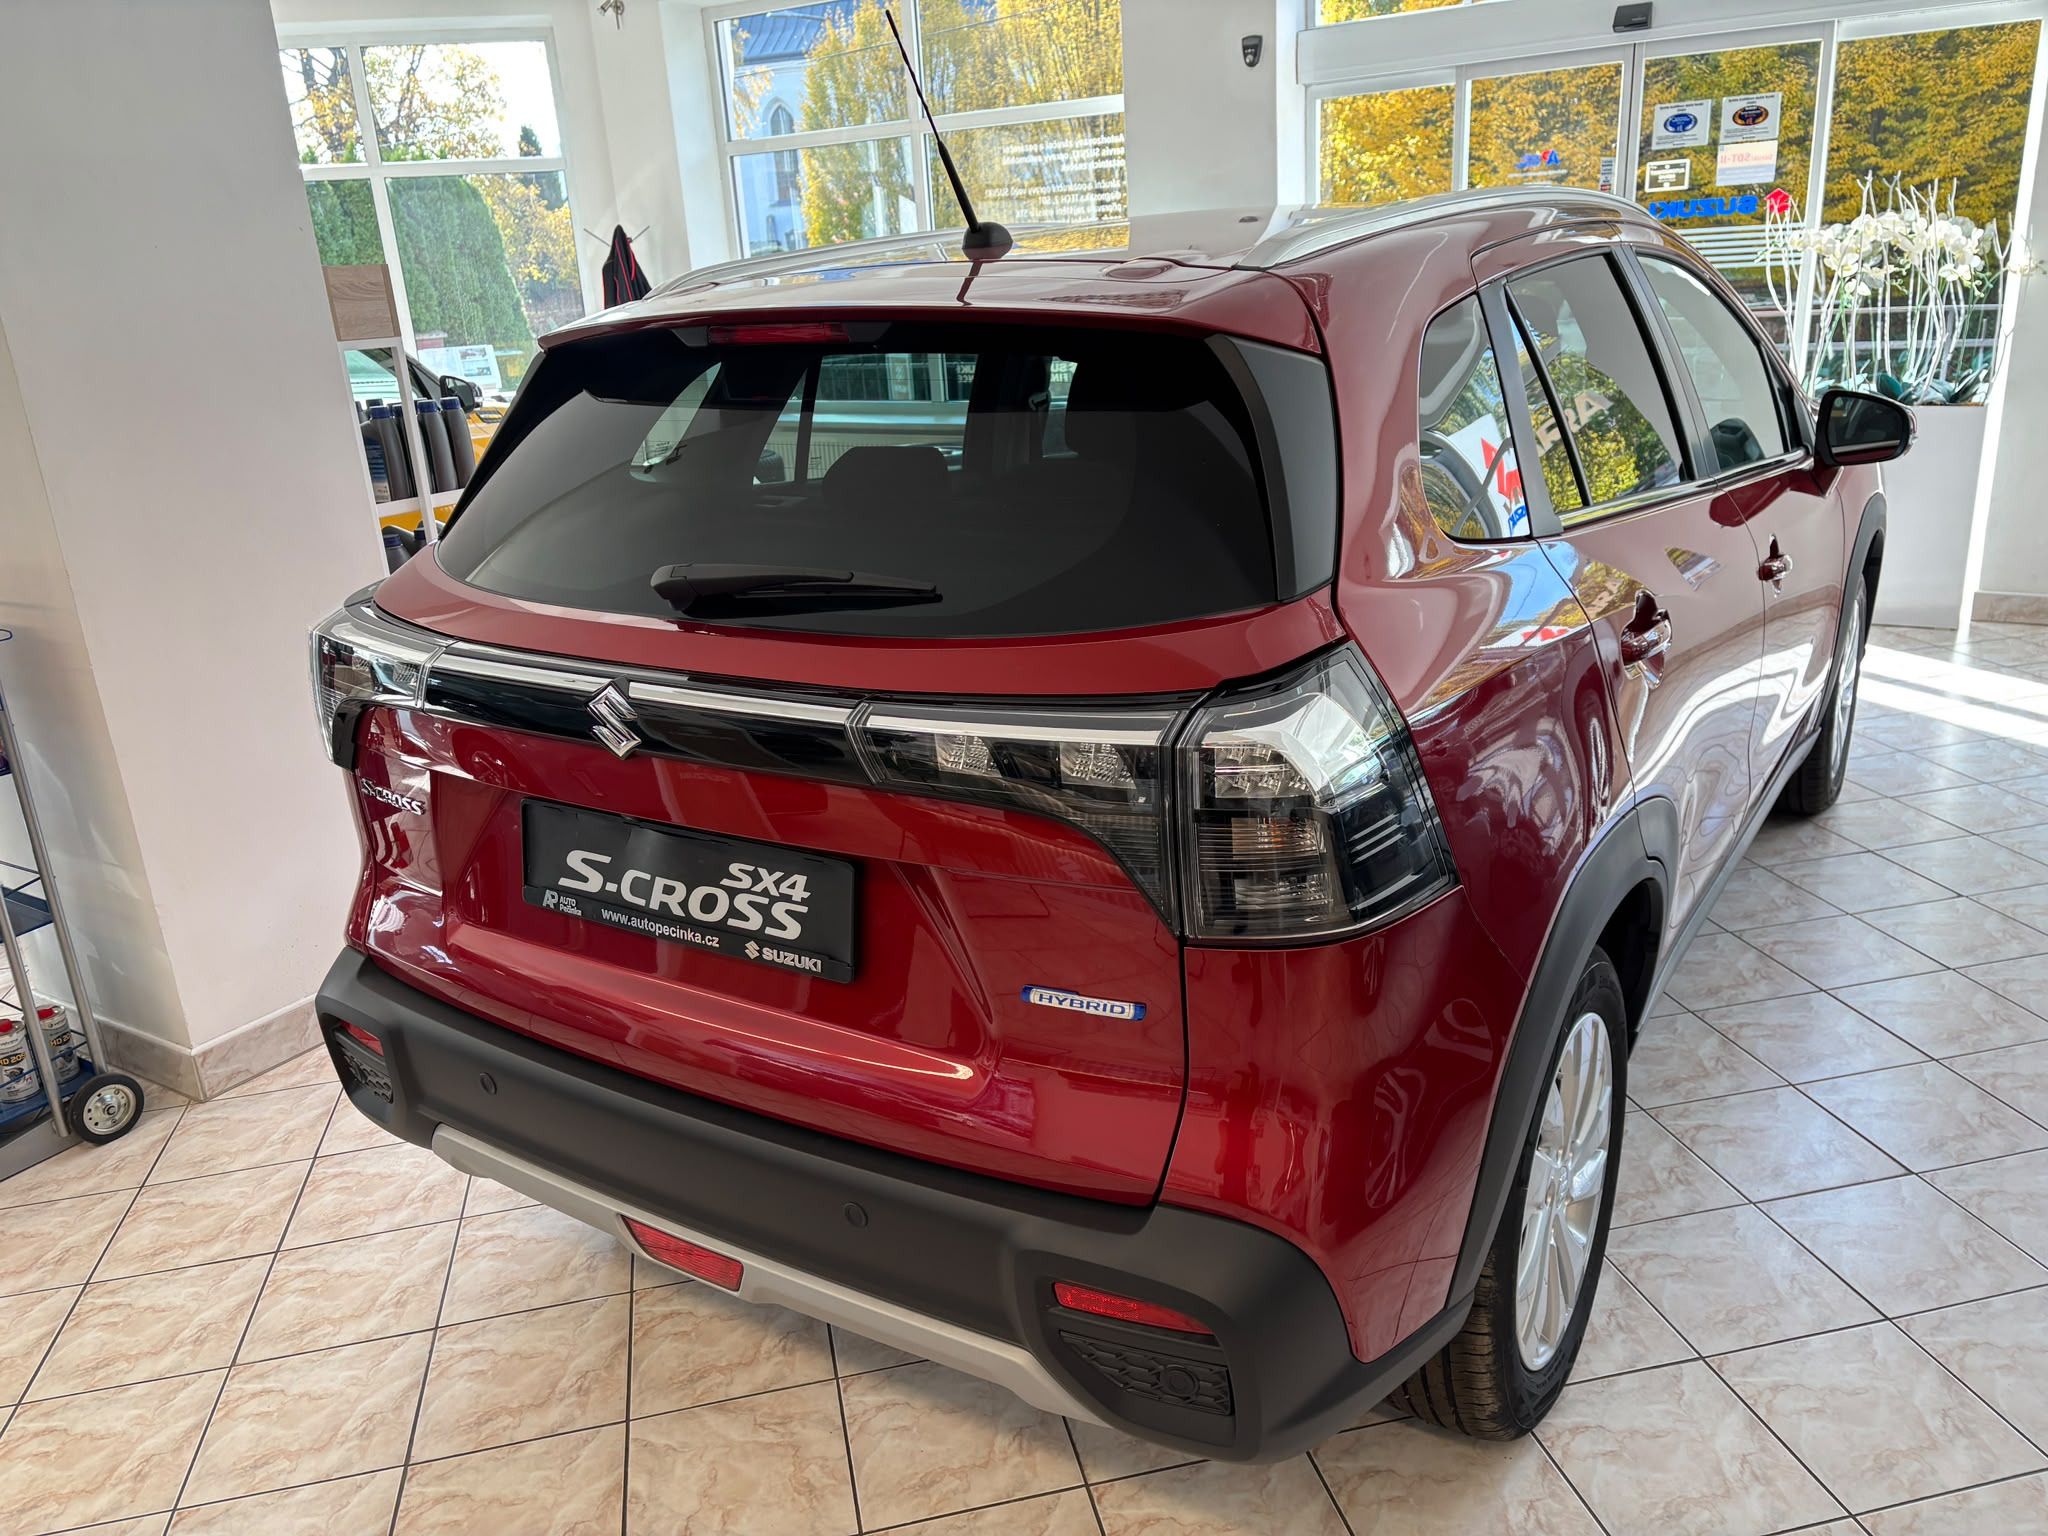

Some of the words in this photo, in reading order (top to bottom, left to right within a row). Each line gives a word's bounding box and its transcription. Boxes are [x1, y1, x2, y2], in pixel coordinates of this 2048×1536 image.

[720, 861, 812, 901] SX4
[559, 896, 576, 907] AUTO
[601, 908, 720, 948] www.autopecinka.cz
[762, 948, 822, 973] SUZUKI
[1038, 993, 1126, 1015] HYBRID
